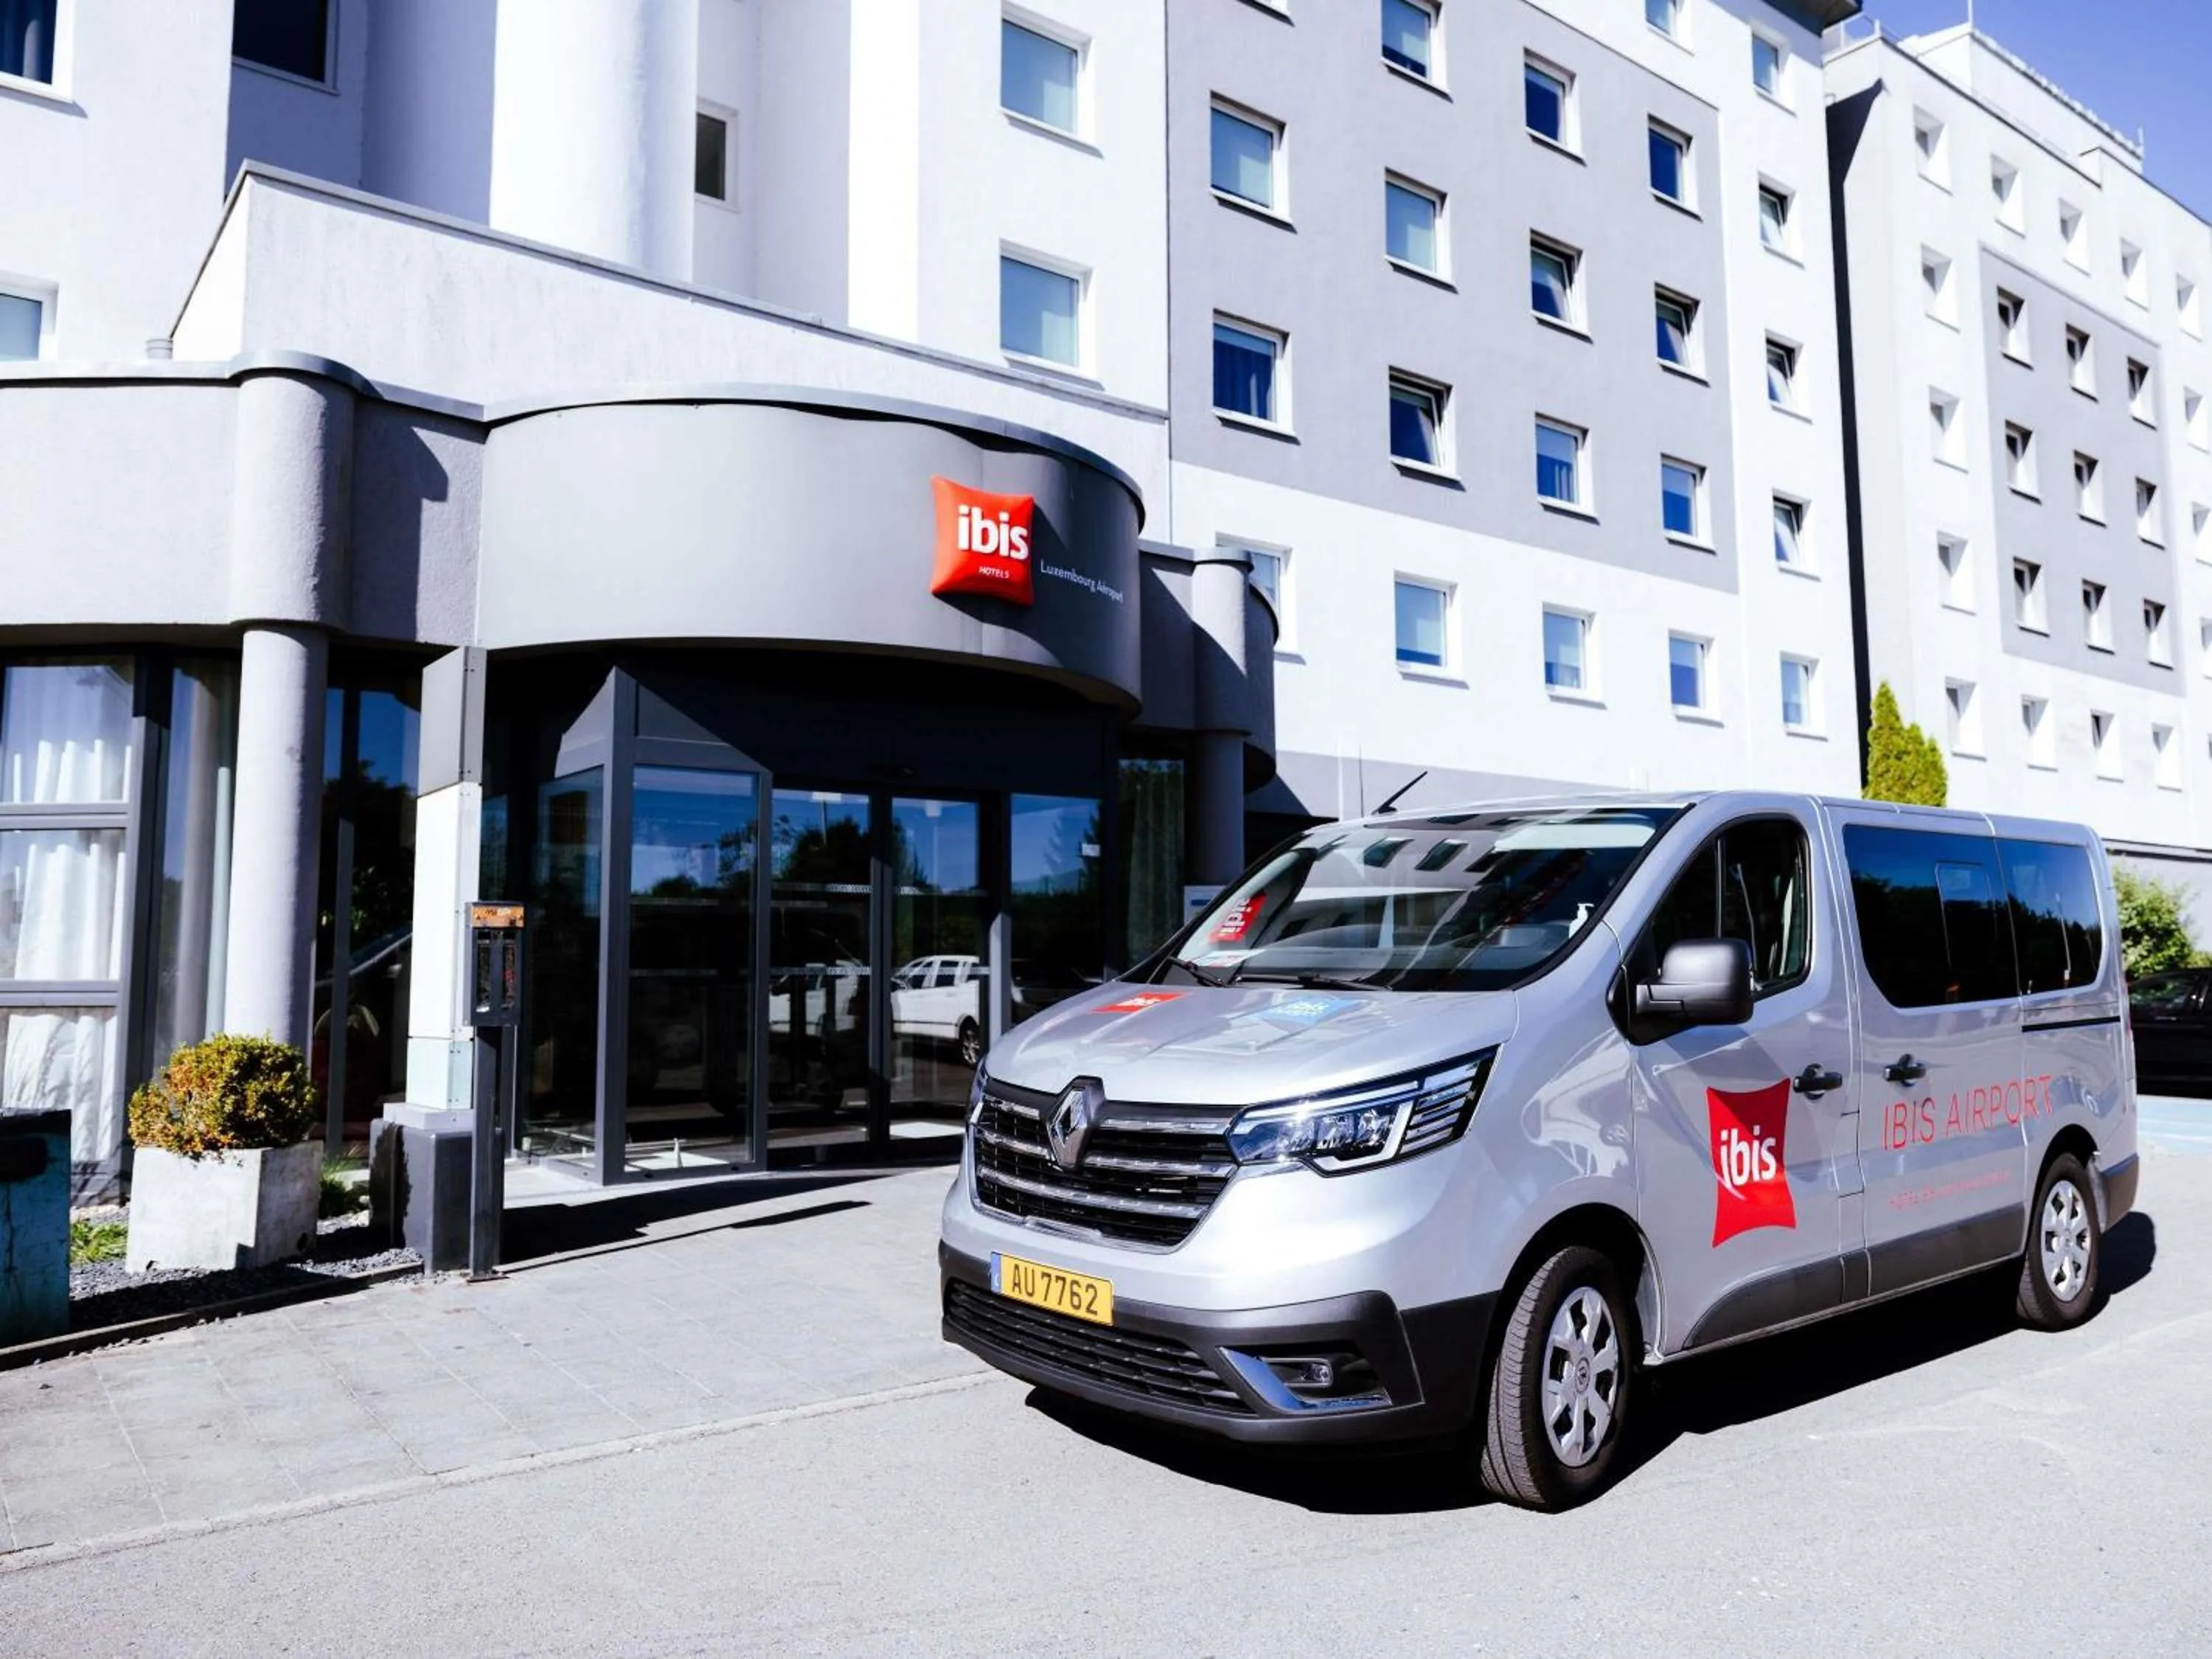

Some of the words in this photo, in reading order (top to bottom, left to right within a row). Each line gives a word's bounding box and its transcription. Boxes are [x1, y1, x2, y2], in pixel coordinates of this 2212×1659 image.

[958, 504, 1029, 560] ibis
[978, 565, 1010, 579] HOTELS
[1040, 559, 1096, 592] Luxembourg
[1882, 1096, 1937, 1151] IBIS
[1947, 1075, 2053, 1137] AIRPORT
[1720, 1125, 1777, 1189] ibis
